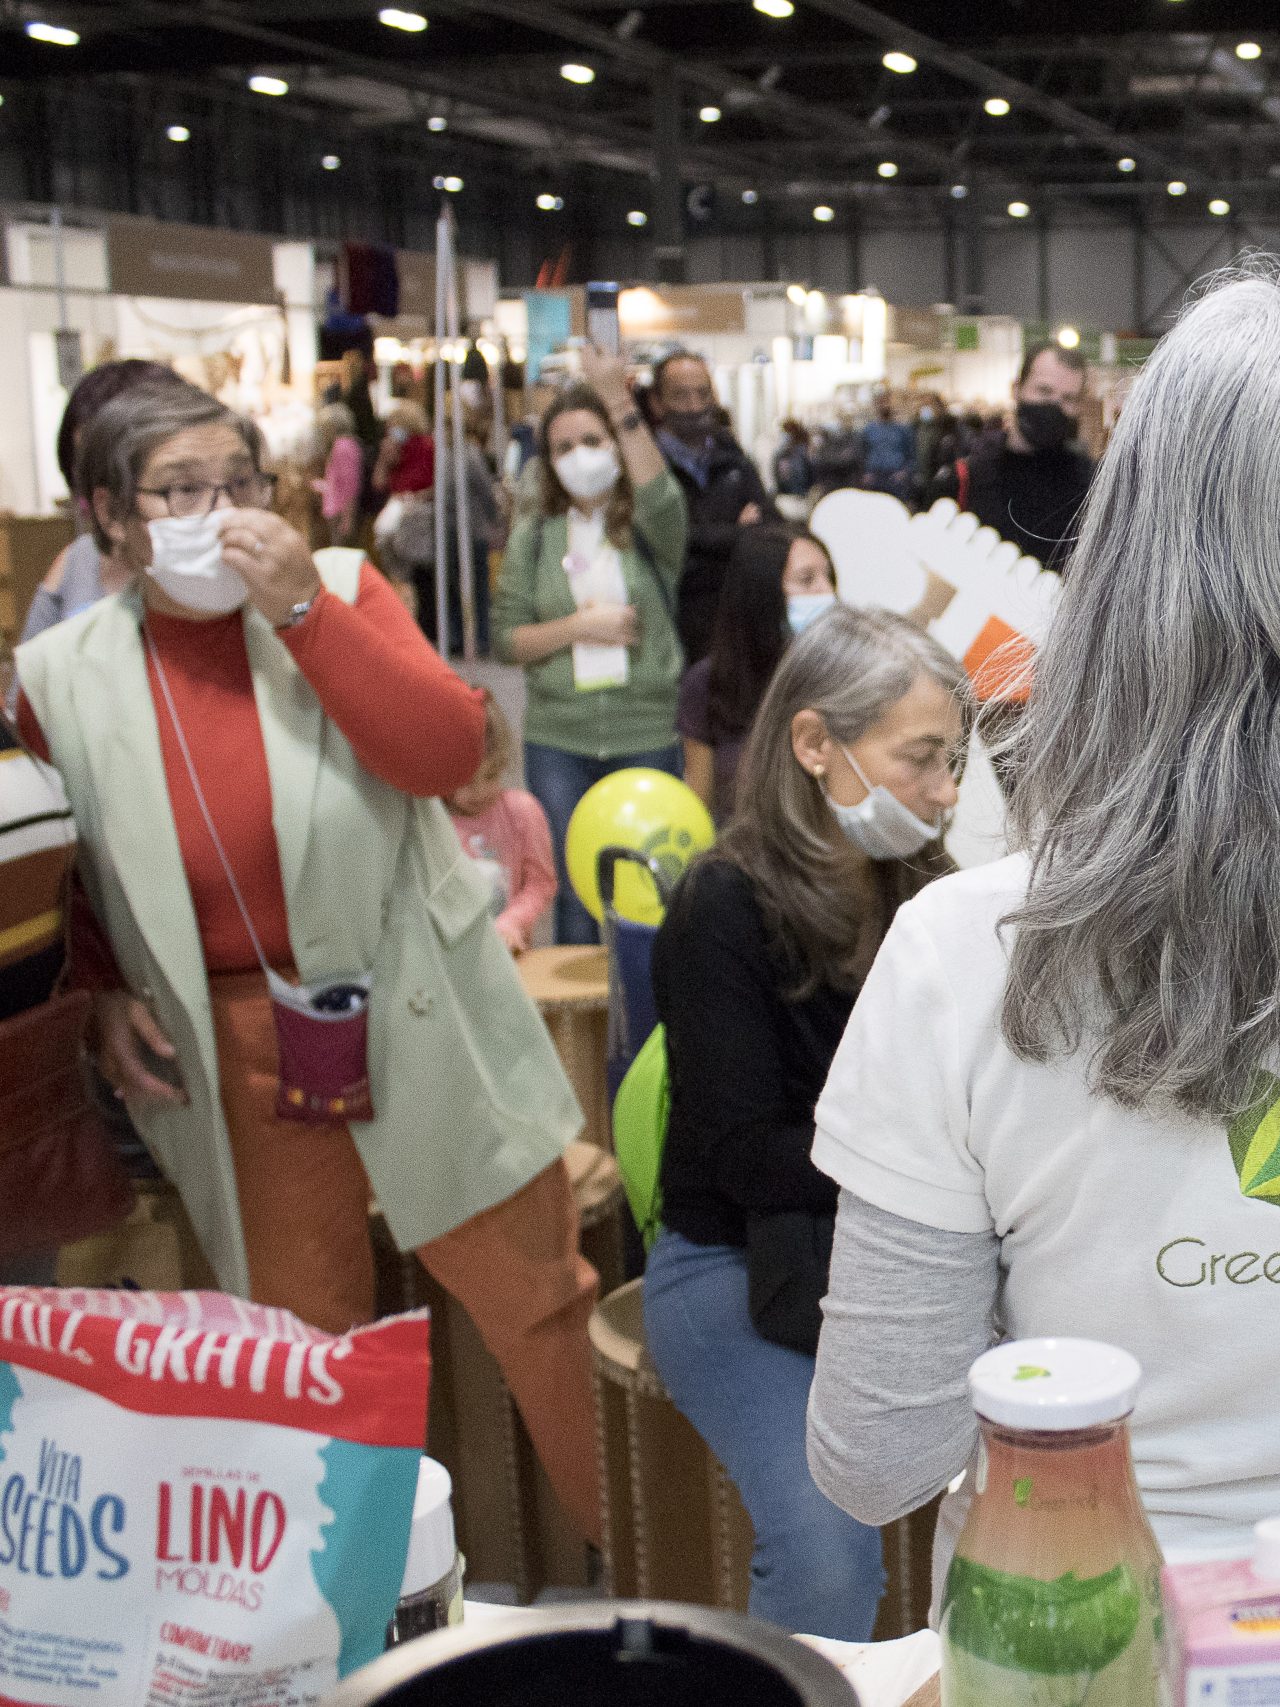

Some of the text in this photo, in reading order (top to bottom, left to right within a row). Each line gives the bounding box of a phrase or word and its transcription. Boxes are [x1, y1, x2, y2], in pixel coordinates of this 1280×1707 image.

[0, 1472, 130, 1582] SEEDS
[156, 1480, 287, 1575] LINO
[155, 1565, 265, 1613] MOLDAS
